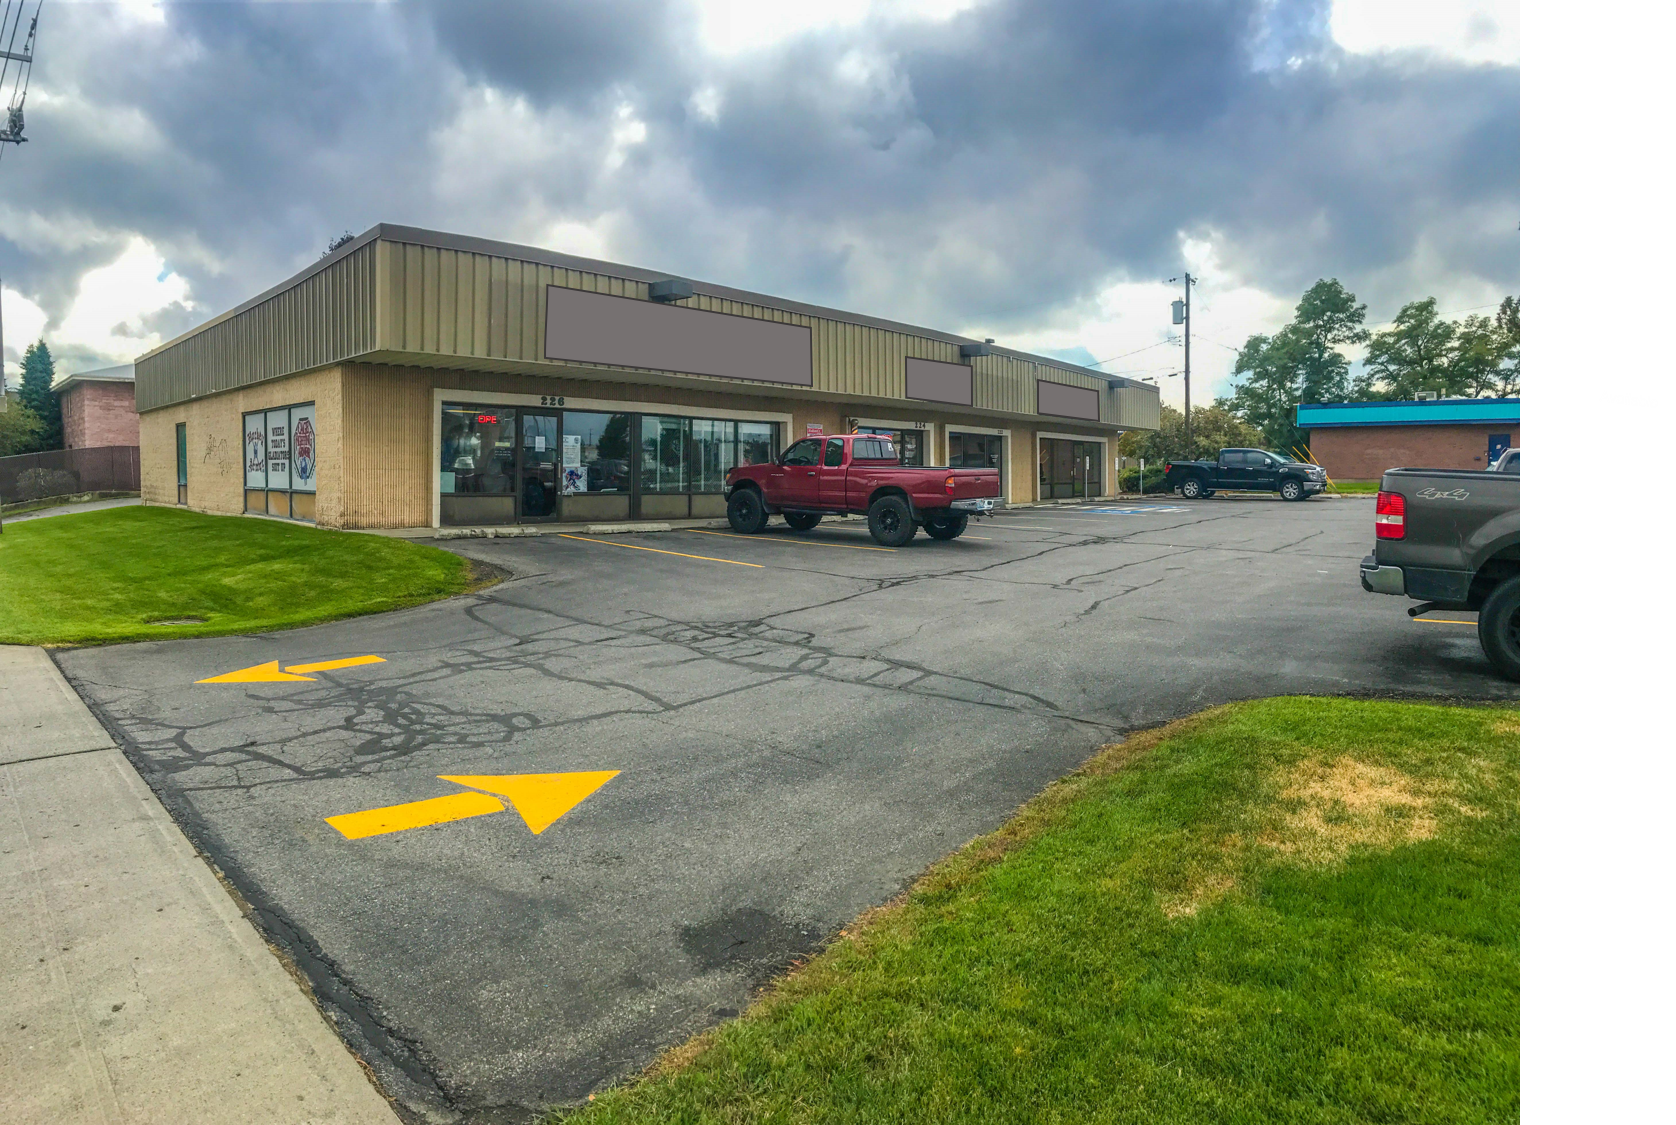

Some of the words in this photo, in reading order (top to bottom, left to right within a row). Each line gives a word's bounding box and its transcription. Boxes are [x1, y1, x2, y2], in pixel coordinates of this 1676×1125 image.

[541, 396, 565, 406] 226
[478, 415, 503, 424] OPE
[271, 426, 285, 437] WHERE
